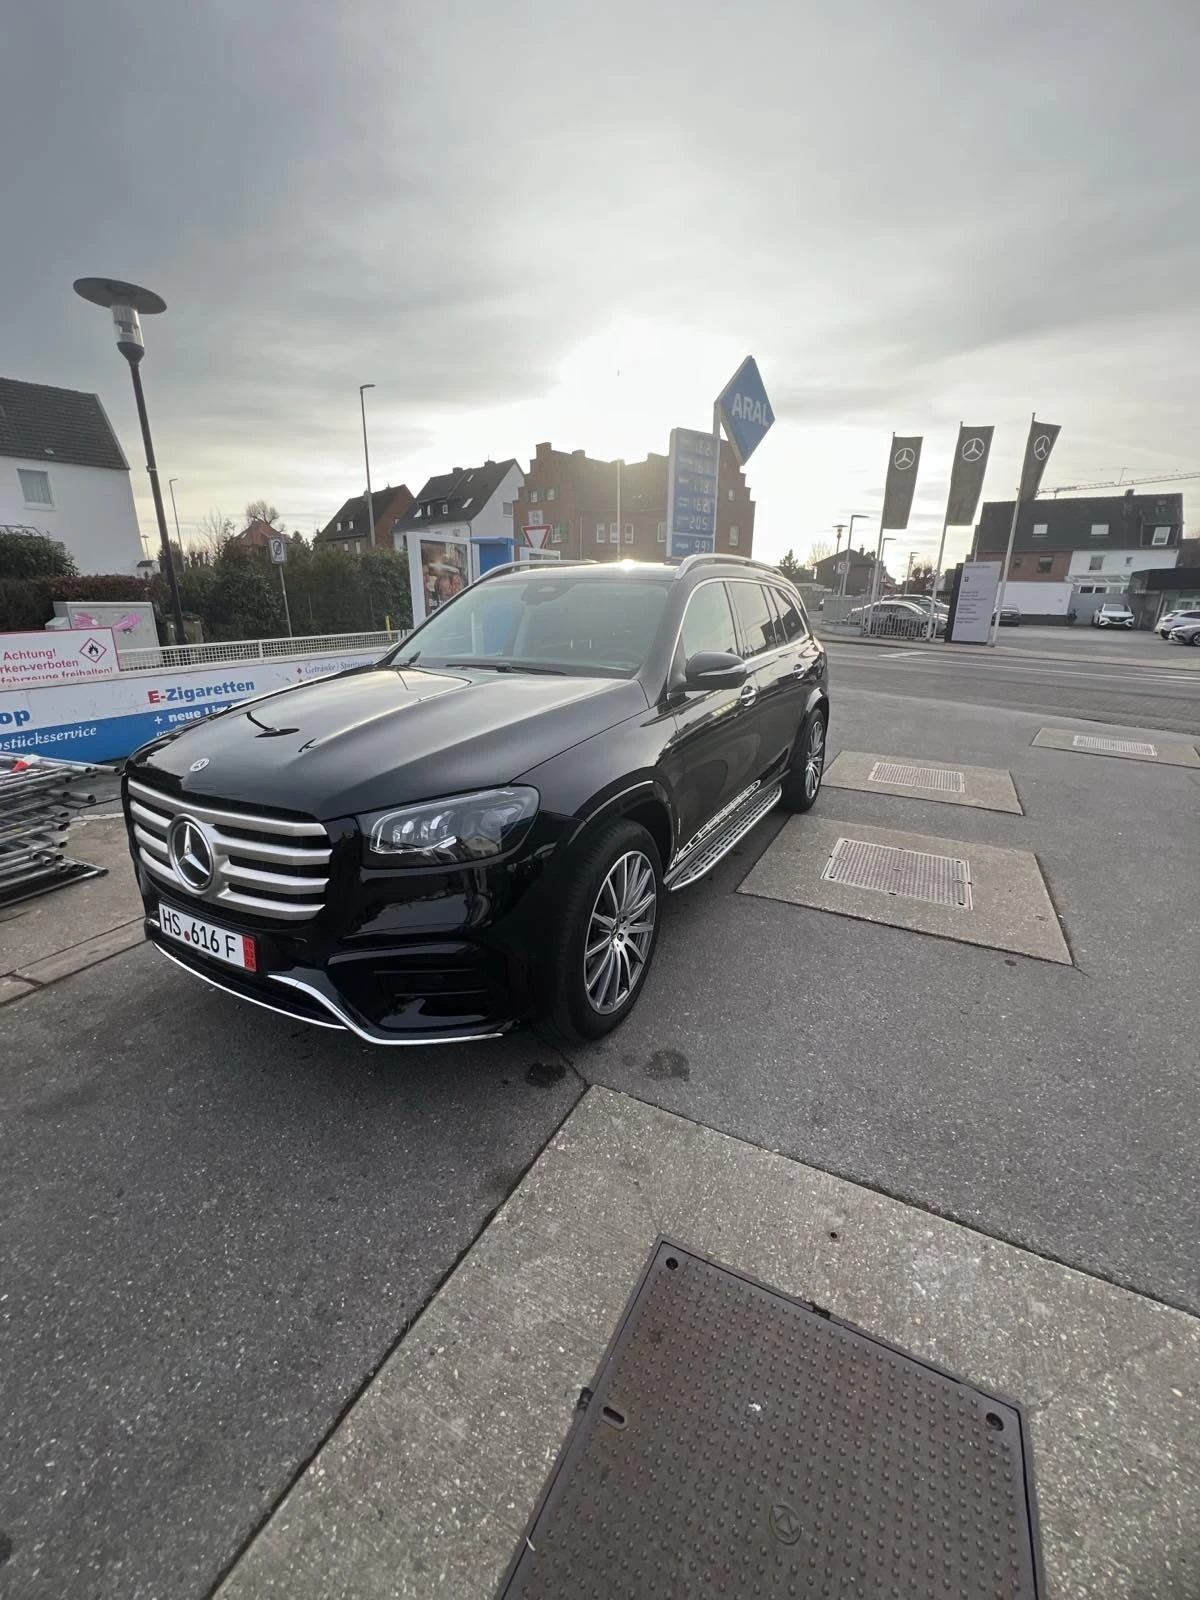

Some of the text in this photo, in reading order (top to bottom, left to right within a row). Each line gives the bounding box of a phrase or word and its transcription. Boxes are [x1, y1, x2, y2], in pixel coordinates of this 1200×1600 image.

[730, 392, 770, 427] ARAL
[3, 648, 57, 661] Achtung!
[147, 680, 255, 704] E-Zigaretten
[168, 710, 201, 723] neue
[162, 908, 182, 937] HS
[191, 921, 220, 954] 616
[225, 934, 236, 958] F
